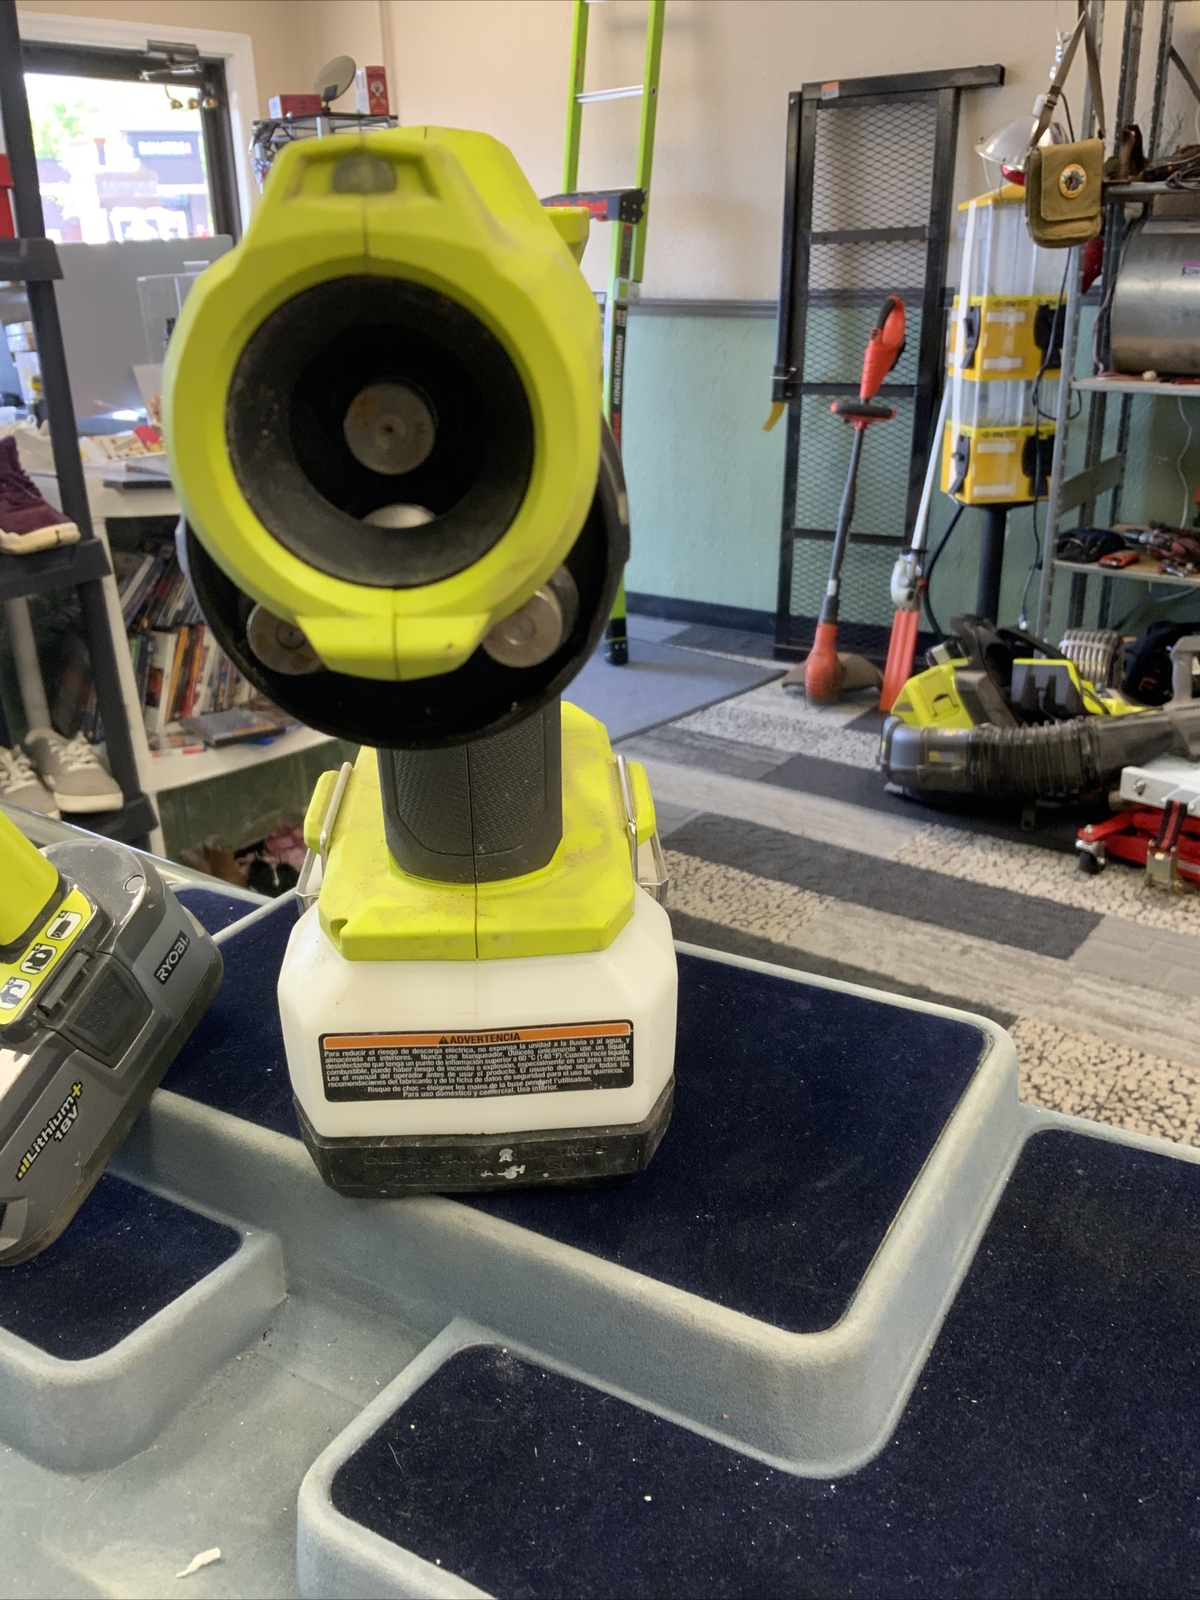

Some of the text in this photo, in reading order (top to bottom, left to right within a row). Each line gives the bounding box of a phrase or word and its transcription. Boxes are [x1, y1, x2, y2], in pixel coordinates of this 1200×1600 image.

[614, 334, 624, 376] KOMBO
[612, 377, 622, 405] KING
[156, 937, 188, 984] RYOBI
[450, 1033, 521, 1044] ADVERTENCIA
[485, 1056, 512, 1064] superior
[537, 1053, 552, 1061] (140
[518, 1060, 565, 1069] especialmente
[457, 1075, 473, 1083] ficha
[484, 1074, 502, 1082] datos
[513, 1072, 545, 1080] seguridad
[486, 1069, 517, 1077] producto.
[480, 1087, 515, 1096] comercial.
[54, 1107, 79, 1143] 18V
